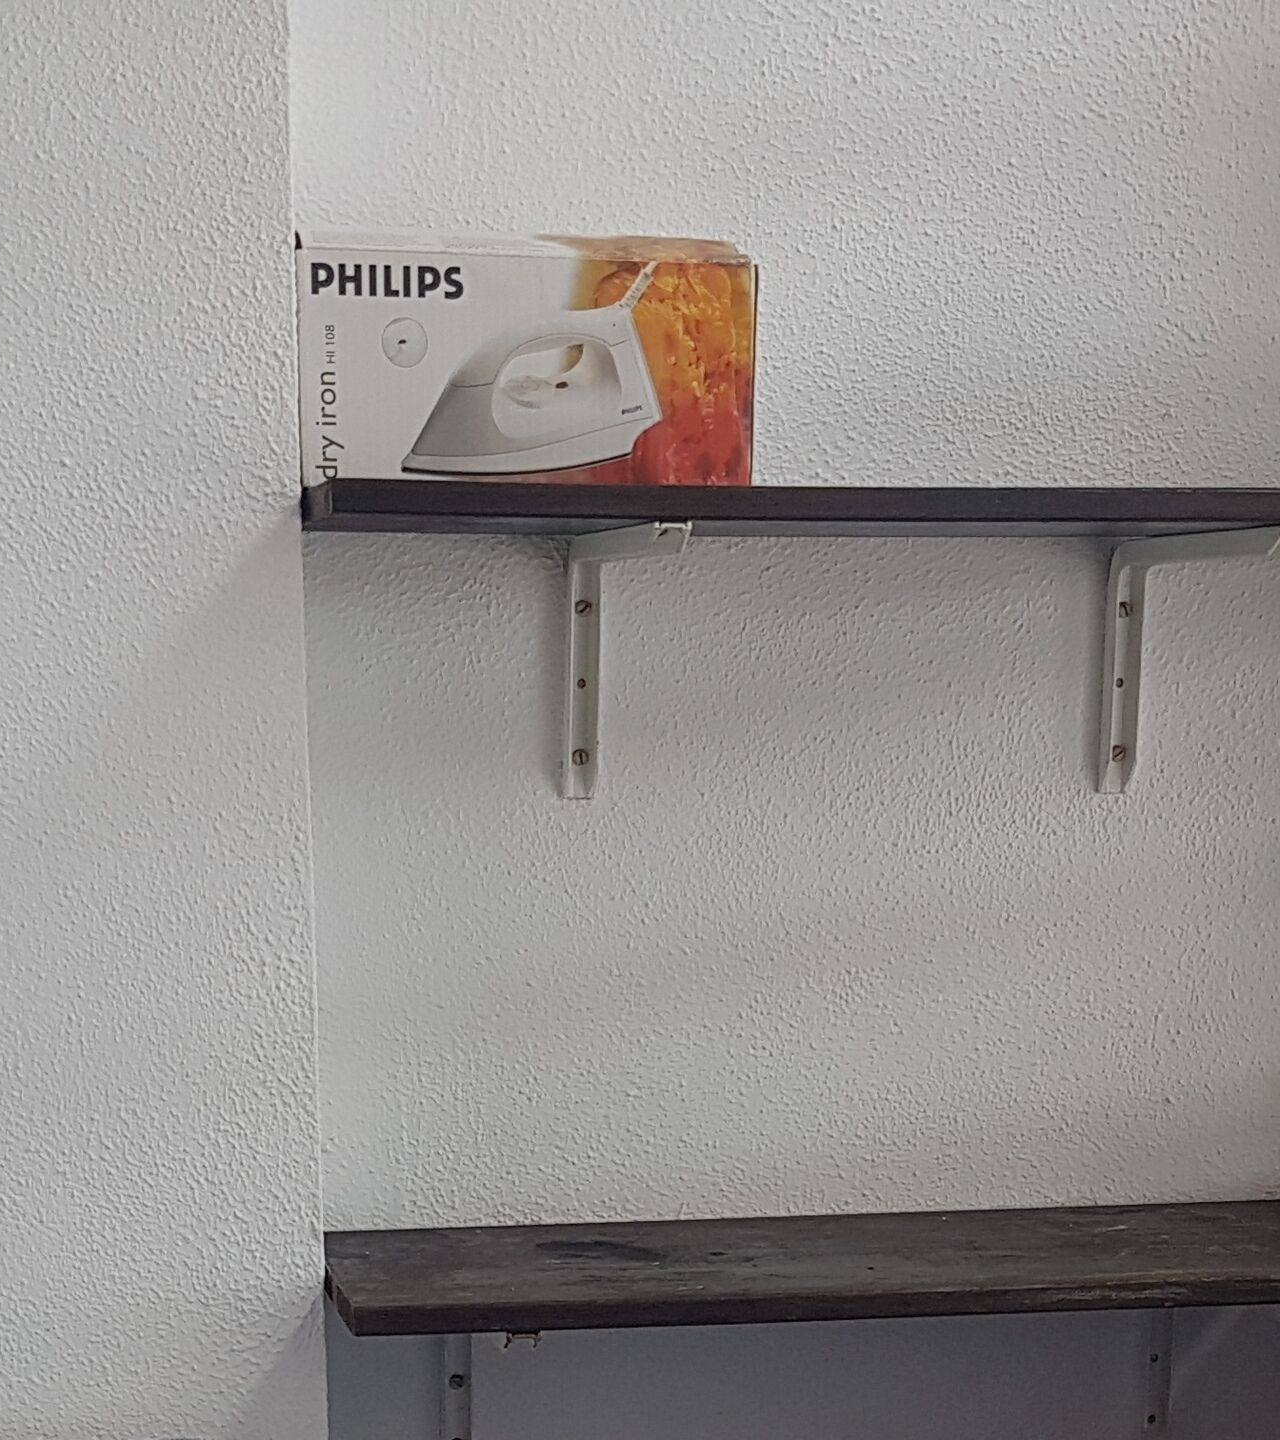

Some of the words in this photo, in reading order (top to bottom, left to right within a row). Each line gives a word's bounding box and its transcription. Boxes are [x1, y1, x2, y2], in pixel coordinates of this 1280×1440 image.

[310, 262, 464, 300] PHILIPS
[324, 324, 335, 346] 108
[326, 351, 336, 364] HI
[316, 371, 337, 426] iron
[315, 435, 345, 480] dry
